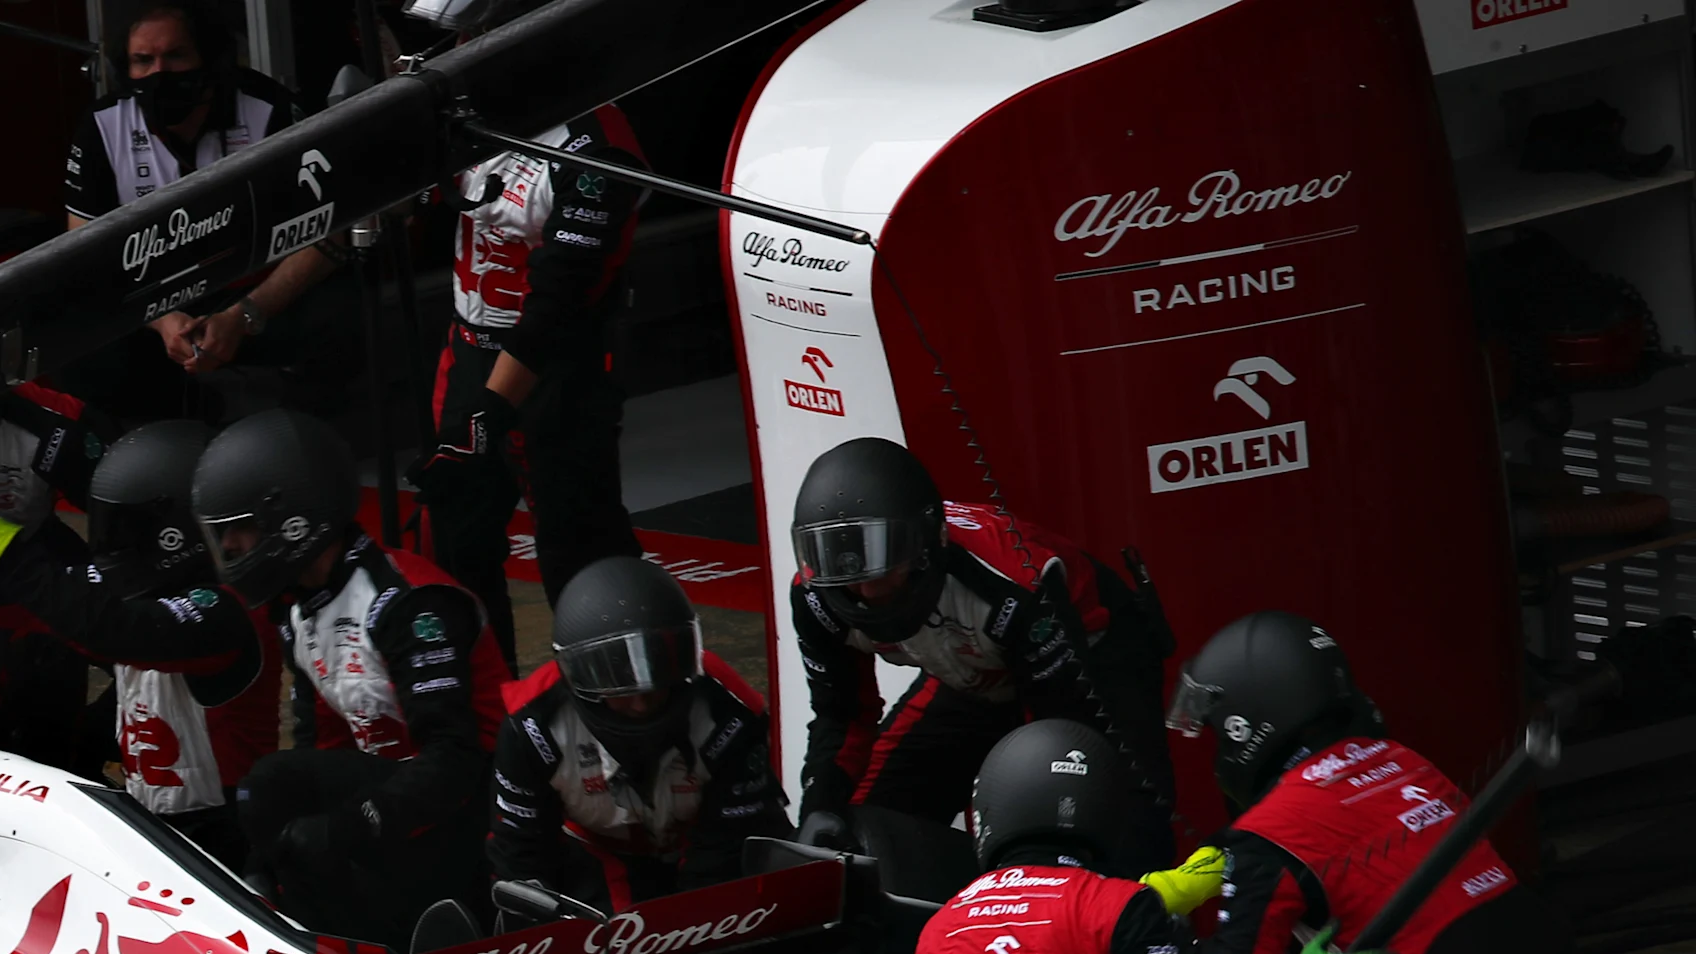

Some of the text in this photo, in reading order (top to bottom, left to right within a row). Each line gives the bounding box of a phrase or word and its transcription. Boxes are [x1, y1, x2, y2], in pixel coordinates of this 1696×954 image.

[1476, 0, 1562, 22] ORL
[271, 210, 330, 256] ORLEN
[1054, 169, 1352, 258] Alfa Romeo
[122, 204, 235, 283] Alfa Romeo
[743, 231, 850, 273] Alfa Romeo
[145, 279, 208, 321] RACING
[766, 292, 827, 317] RACING
[1131, 265, 1296, 315] RACING
[787, 384, 843, 414] ORLEN
[1156, 431, 1300, 484] ORLEN
[1403, 799, 1451, 829] ORLEN
[995, 868, 1072, 890] Romeo
[968, 902, 1031, 920] RACING
